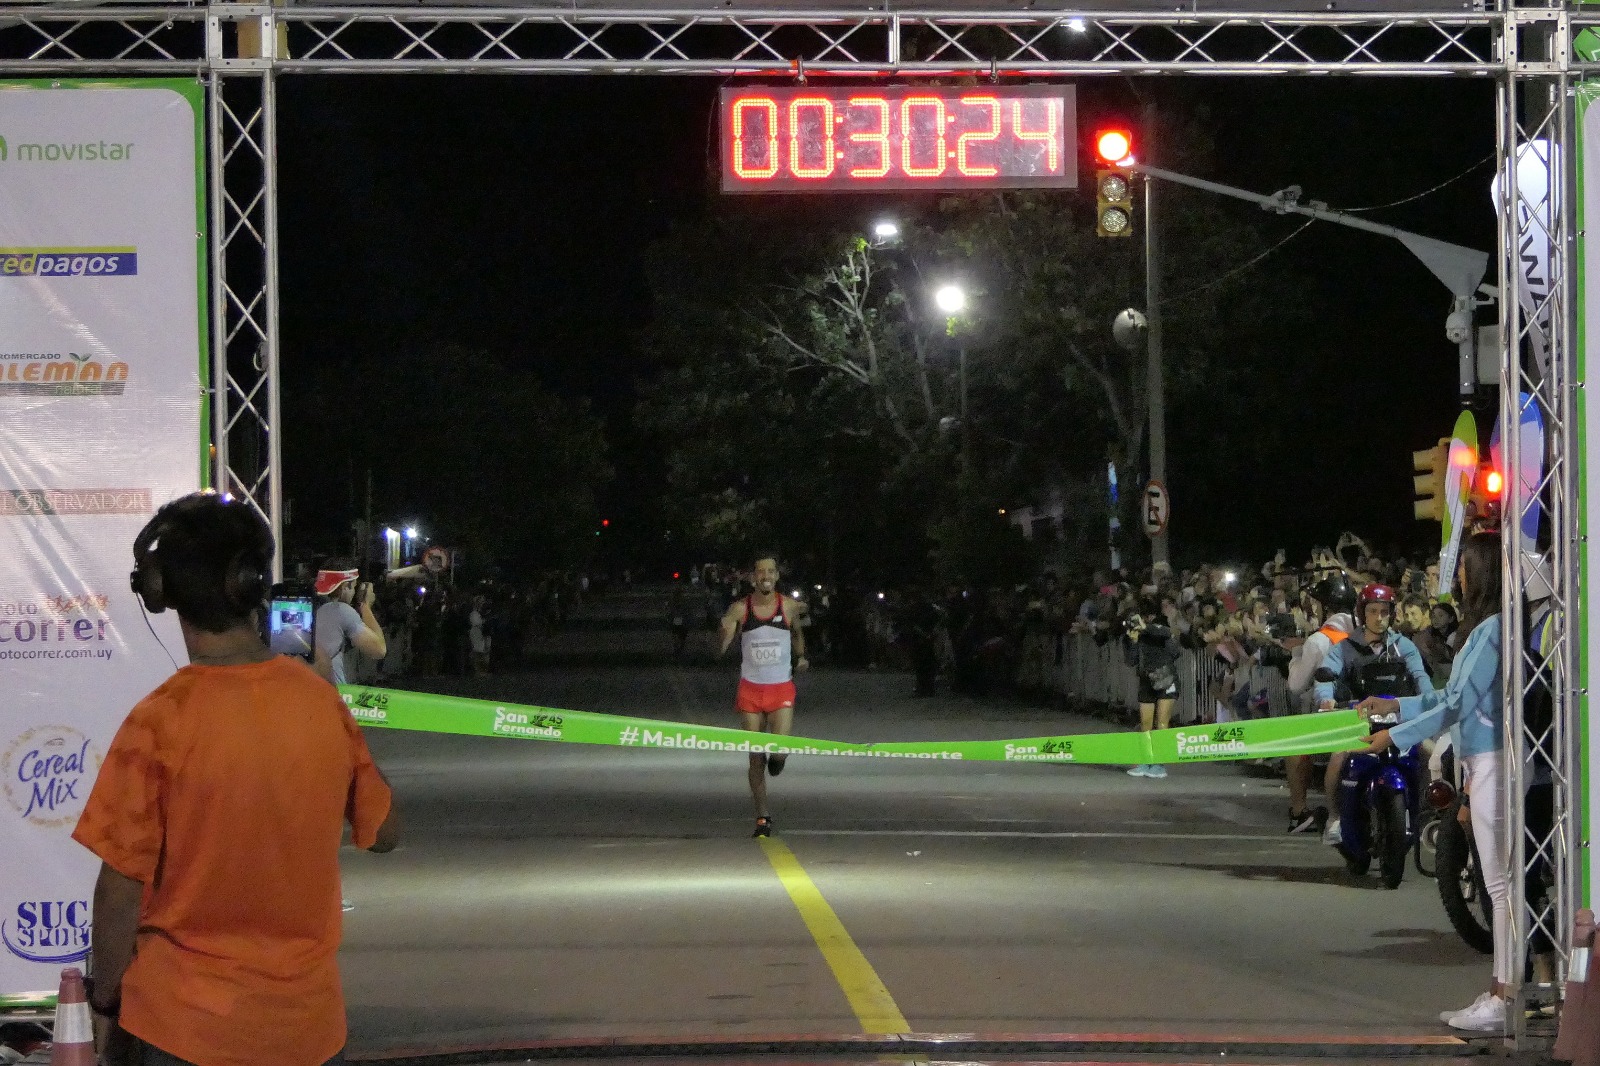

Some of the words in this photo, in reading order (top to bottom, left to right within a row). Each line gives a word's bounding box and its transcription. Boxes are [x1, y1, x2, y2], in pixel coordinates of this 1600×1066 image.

[733, 97, 1057, 178] 00:30:24
[18, 140, 134, 161] movistar
[4, 602, 38, 615] oto
[0, 649, 113, 660] otocorrer.com.uy
[351, 706, 386, 718] ando
[496, 706, 528, 723] San
[494, 717, 562, 736] Fernando
[1176, 732, 1209, 744] San
[1005, 744, 1038, 754] San
[1177, 739, 1246, 754] Fernando
[18, 739, 91, 782] Cereal
[1005, 750, 1073, 760] Fernando
[23, 777, 78, 818] Mix
[17, 901, 92, 929] SUC
